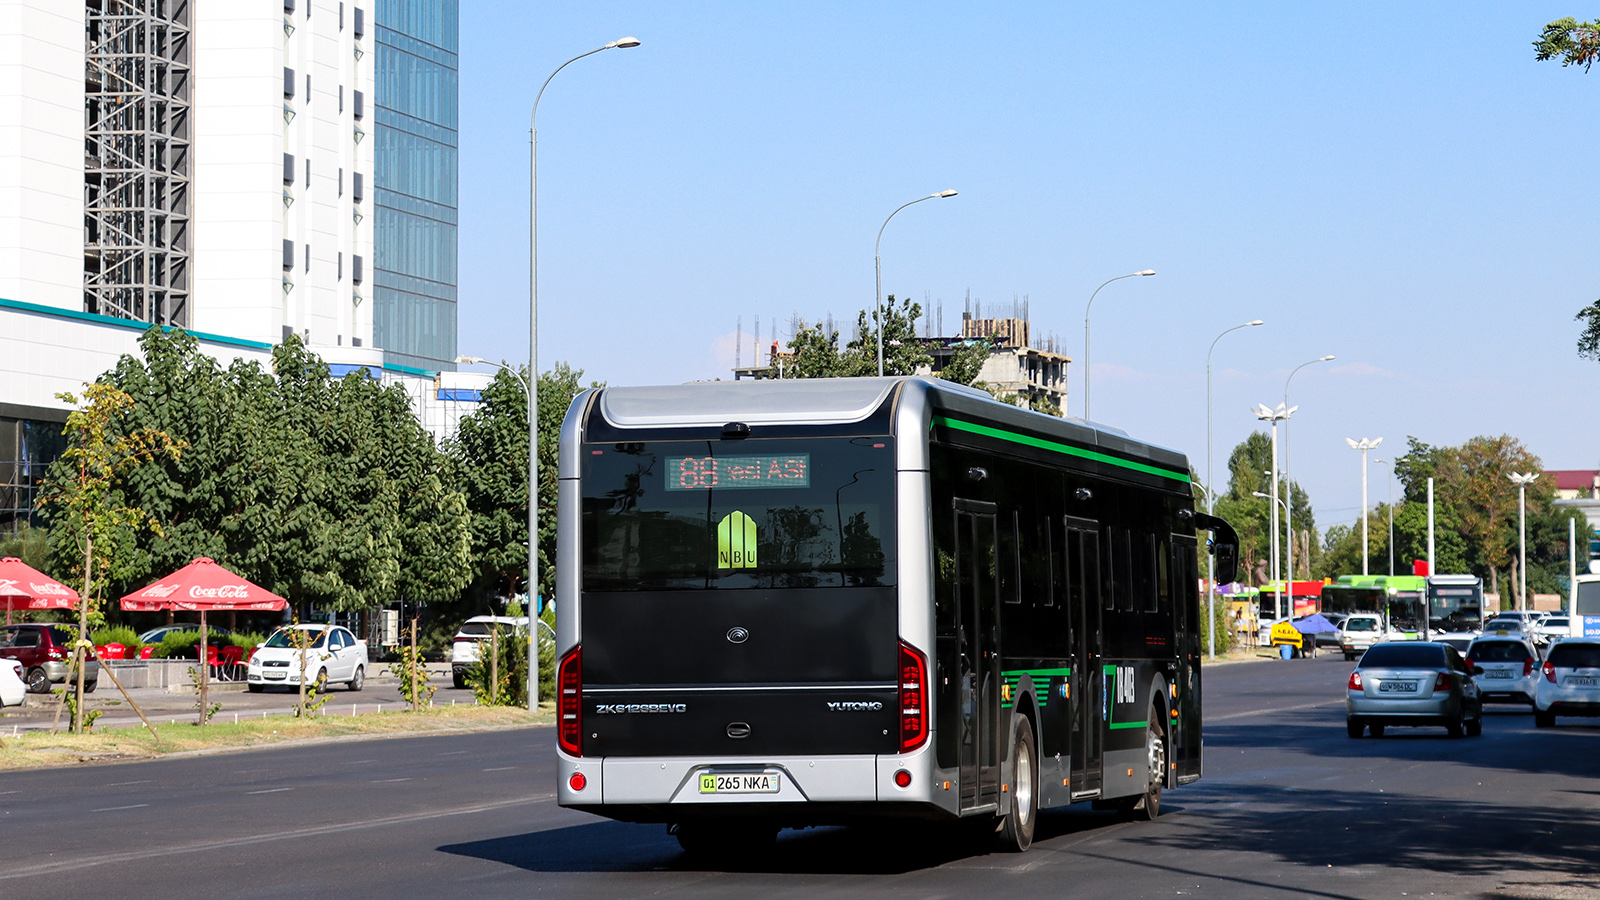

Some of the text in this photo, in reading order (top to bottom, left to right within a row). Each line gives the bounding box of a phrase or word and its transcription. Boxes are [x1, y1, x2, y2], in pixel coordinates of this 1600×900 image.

[680, 457, 718, 488] 88
[719, 550, 756, 564] NBU
[189, 585, 249, 598] Coca-Cola
[826, 701, 883, 711] YUTONG
[703, 776, 770, 790] 01 265 NKA
